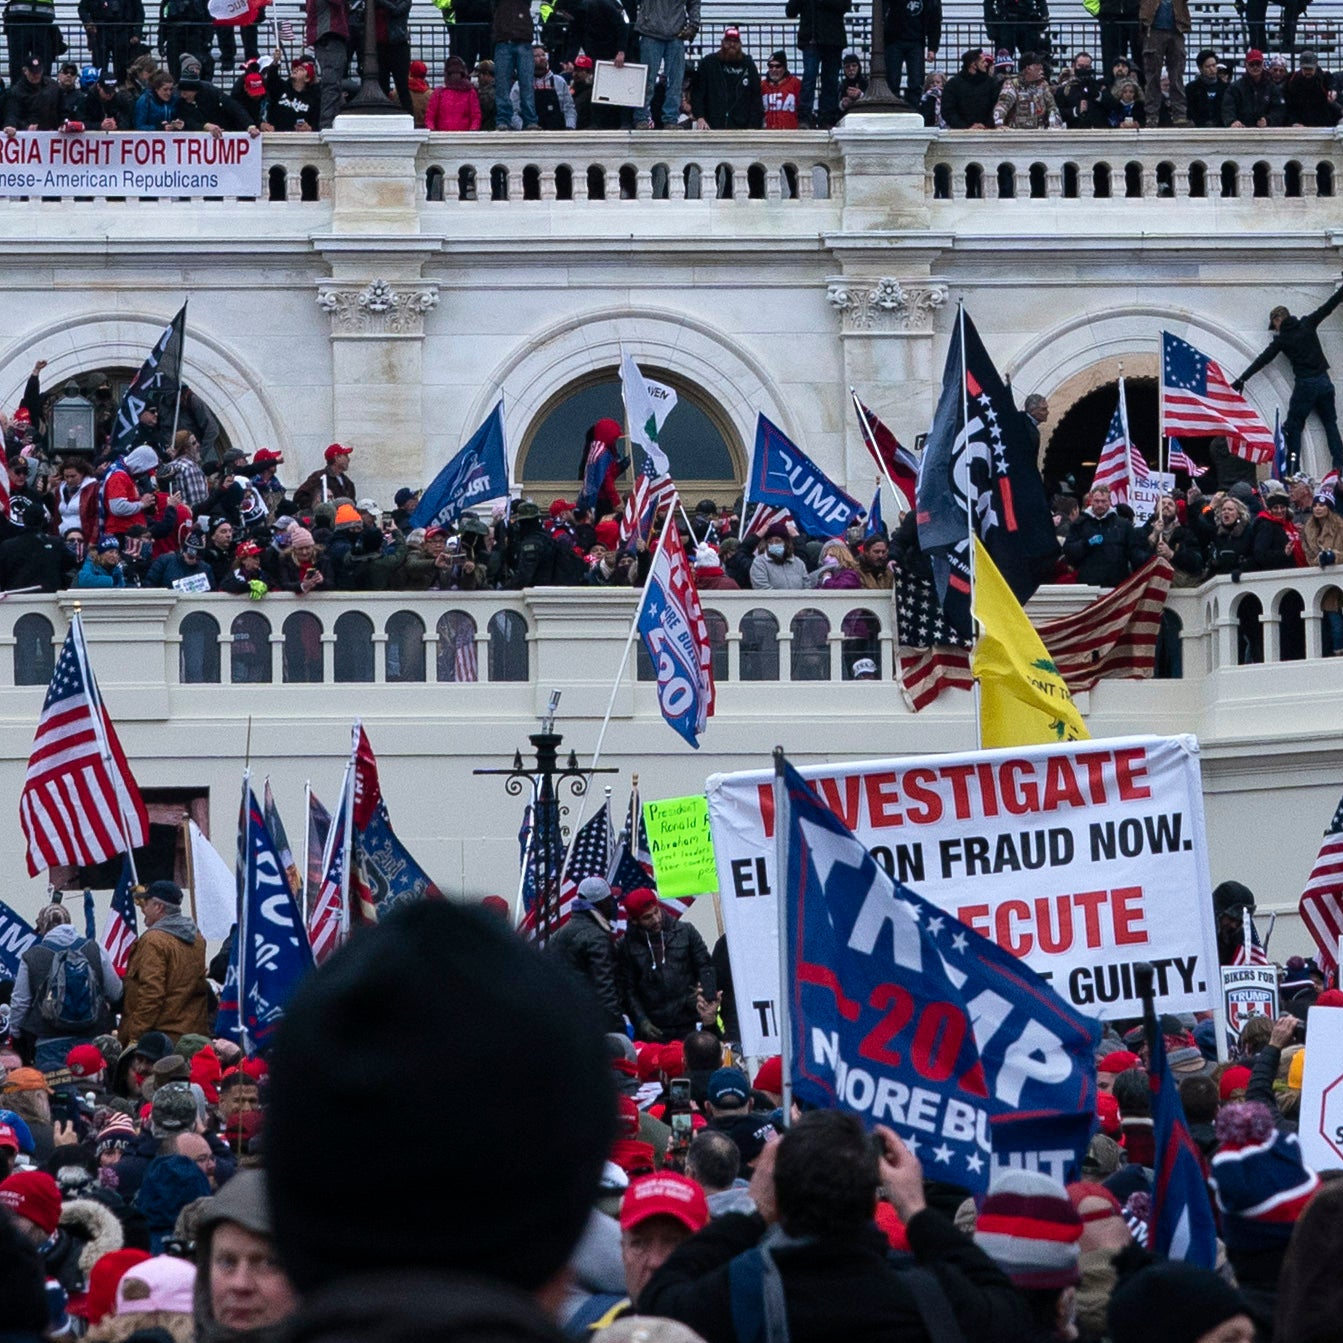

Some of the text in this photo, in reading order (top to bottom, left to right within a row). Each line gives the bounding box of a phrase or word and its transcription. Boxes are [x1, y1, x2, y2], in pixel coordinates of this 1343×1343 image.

[49, 138, 115, 166] FIGHT
[121, 139, 166, 165] FOR
[172, 138, 250, 165] TRUMP
[123, 169, 219, 192] Republicans
[779, 449, 851, 523] UMP
[758, 747, 1153, 839] IVESTIGATE
[731, 812, 1193, 898] ELON FRAUD NOW.
[955, 885, 1150, 959] ECUTE
[1223, 969, 1275, 985] BIKERS FOR
[1230, 991, 1271, 1003] TRUMP
